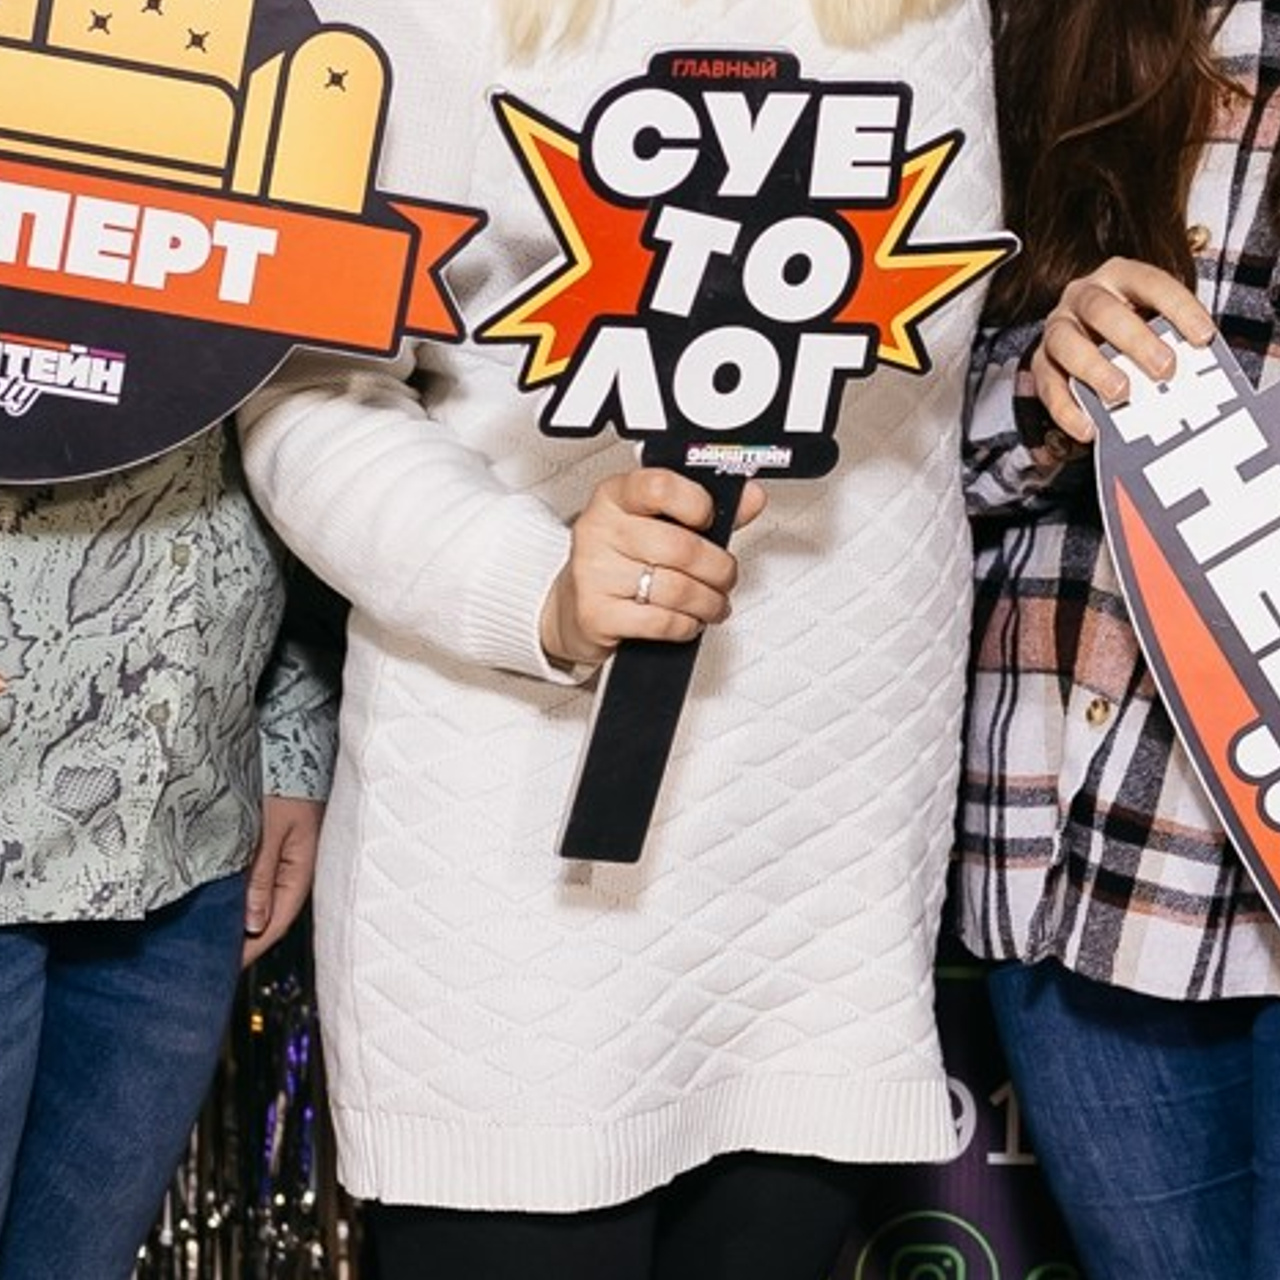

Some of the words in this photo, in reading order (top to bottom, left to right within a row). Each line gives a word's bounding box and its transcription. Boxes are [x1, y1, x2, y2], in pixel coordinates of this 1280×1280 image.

[671, 56, 777, 78] ГЛАВНЫЙ
[591, 88, 900, 199] СУЕ
[0, 180, 278, 304] ПЕРТ
[649, 205, 851, 322] ТО
[0, 342, 125, 395] ТЕЙН
[549, 326, 870, 433] ЛОГ
